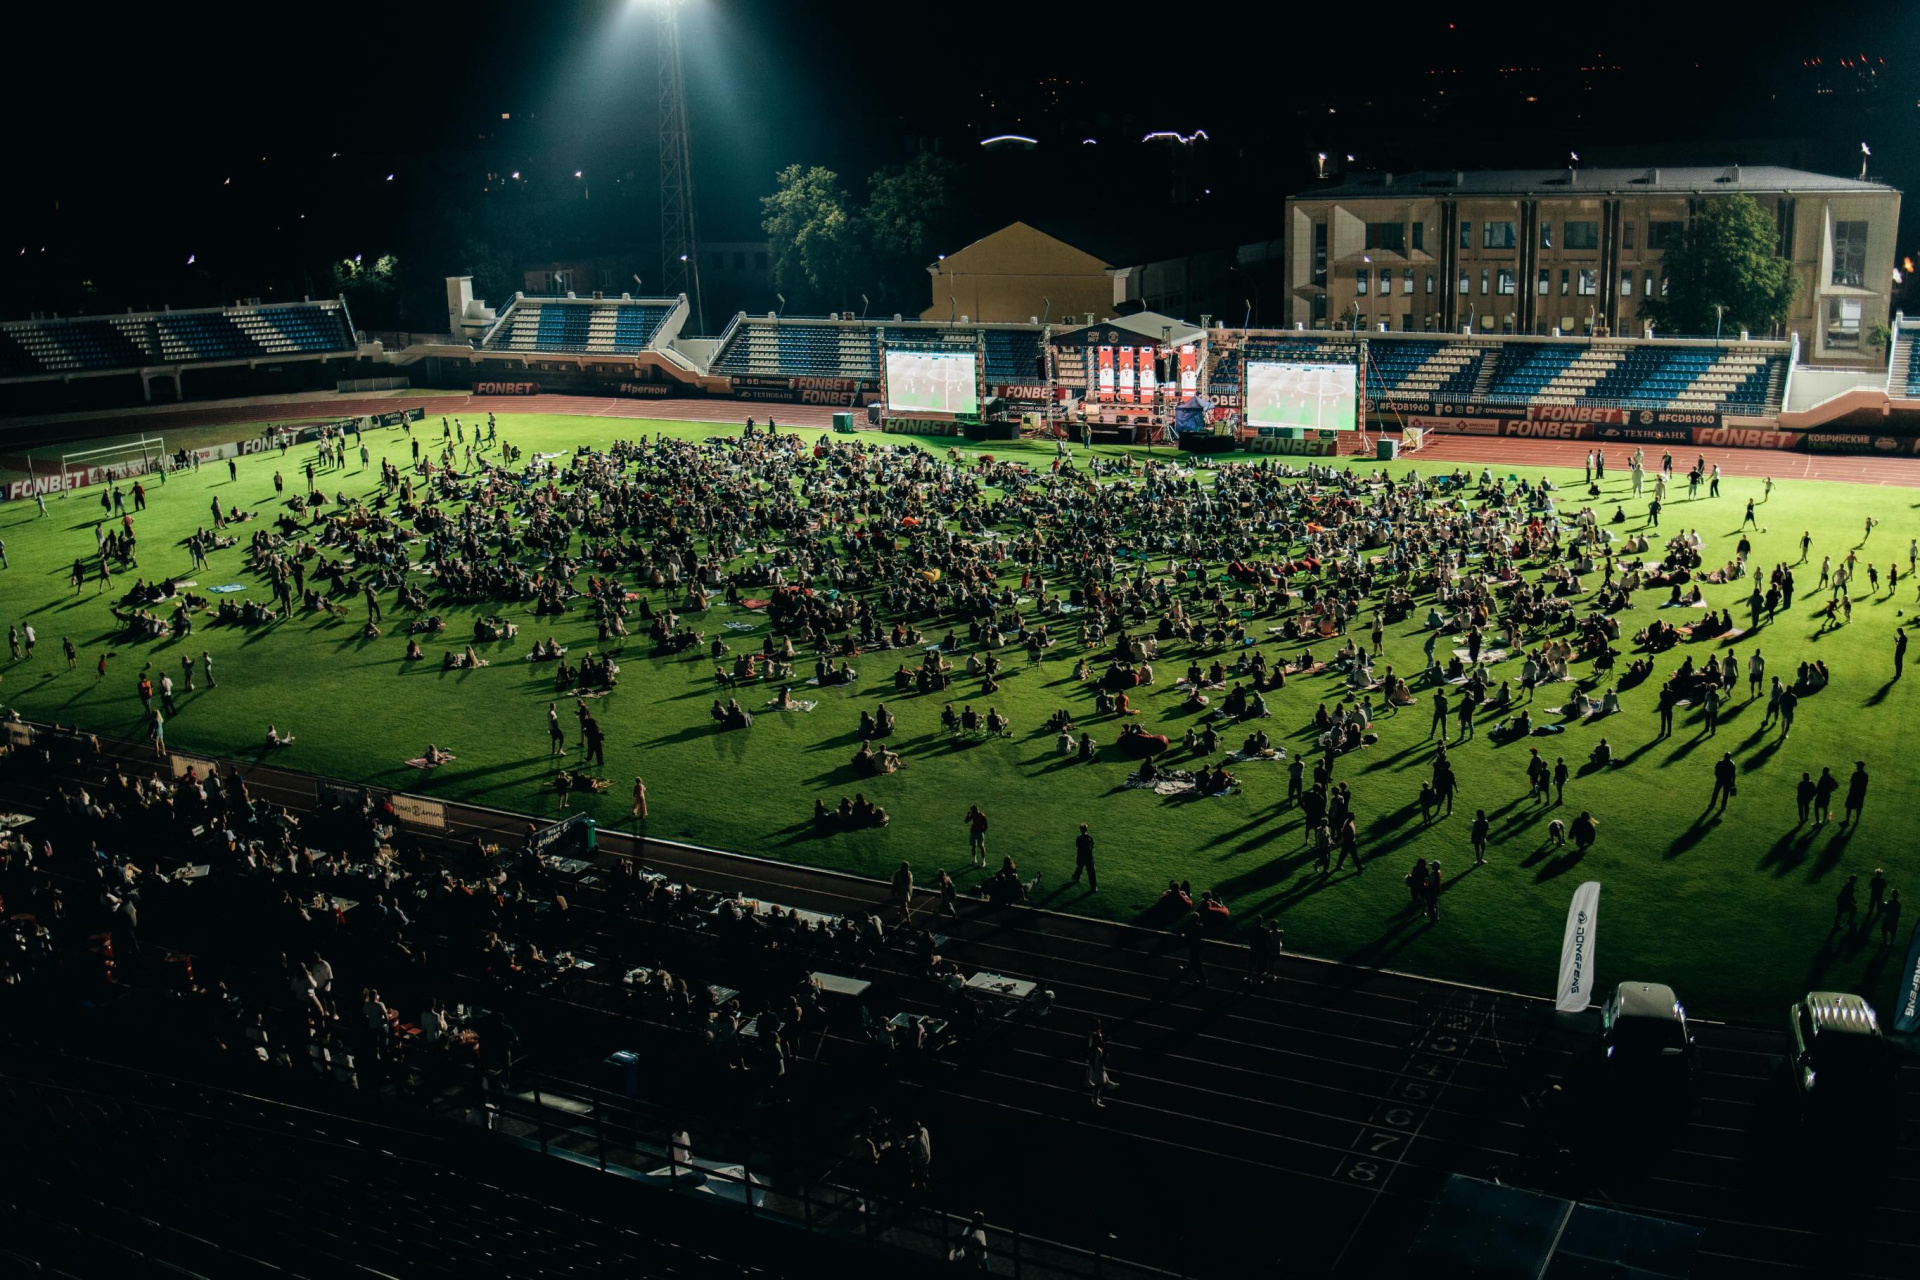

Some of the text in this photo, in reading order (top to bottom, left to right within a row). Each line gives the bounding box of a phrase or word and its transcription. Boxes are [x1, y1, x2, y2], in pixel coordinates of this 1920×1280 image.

[477, 382, 533, 395] FONBET
[619, 382, 667, 395] #1регион
[797, 378, 852, 391] FONBET
[1006, 386, 1049, 398] FONBE
[753, 392, 793, 400] ТЕХНОБАНК
[801, 391, 855, 405] FONBET
[1379, 401, 1429, 412] #FCDB1960
[1539, 406, 1617, 423] FONBET
[885, 418, 953, 435] FONBET
[1658, 412, 1715, 424] #FCDB1960
[1504, 420, 1586, 438] FONBET
[1623, 429, 1686, 439] ТЕХНОБАНК
[1249, 438, 1333, 455] FONBET
[1698, 429, 1793, 448] FONBET
[1808, 433, 1870, 445] КОБРИНСКИЕ
[10, 471, 84, 500] FONBET
[1571, 927, 1585, 994] DONGFENG
[1400, 1082, 1429, 1100] 5
[1385, 1108, 1415, 1126] 6
[1370, 1132, 1400, 1152] 7
[1348, 1161, 1379, 1181] 8
